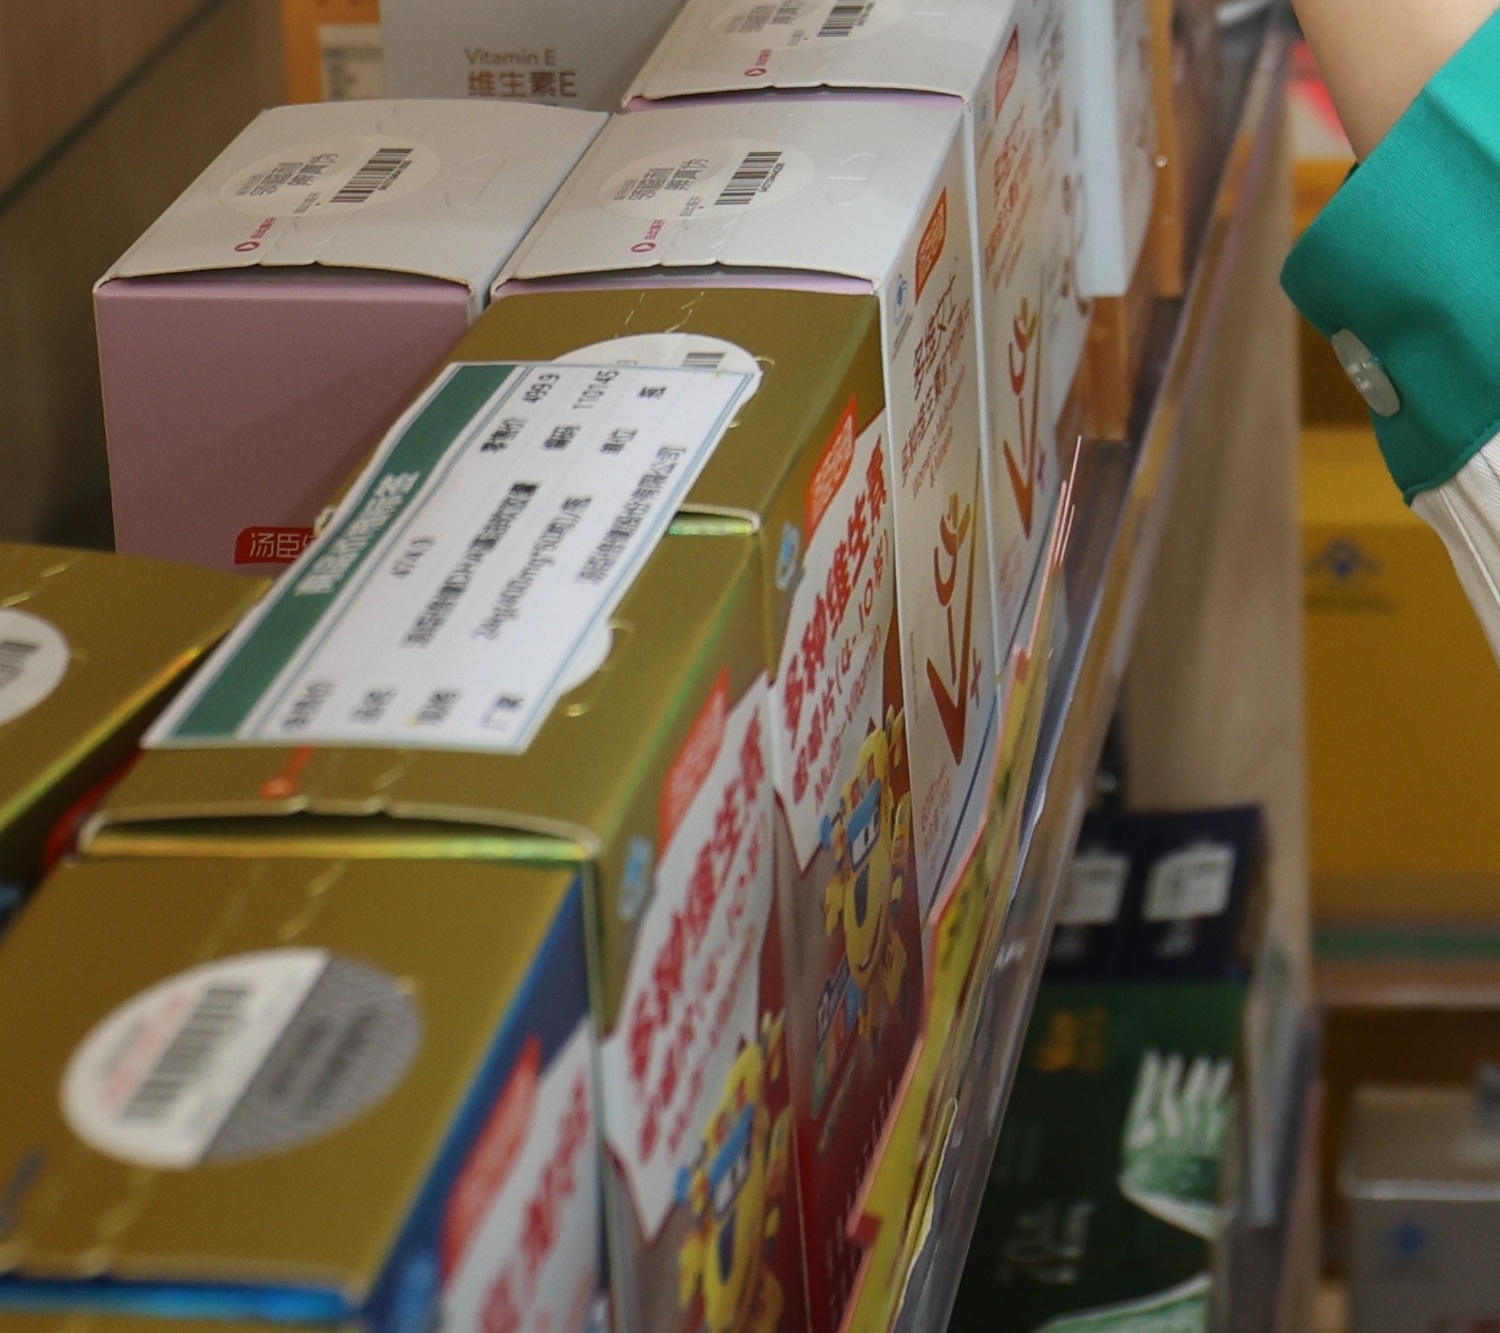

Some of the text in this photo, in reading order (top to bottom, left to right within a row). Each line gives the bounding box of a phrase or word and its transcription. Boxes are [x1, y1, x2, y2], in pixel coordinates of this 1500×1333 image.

[464, 47, 557, 66] Vitamin E
[468, 70, 578, 98] 维生素E
[784, 434, 888, 744] 多种维生素
